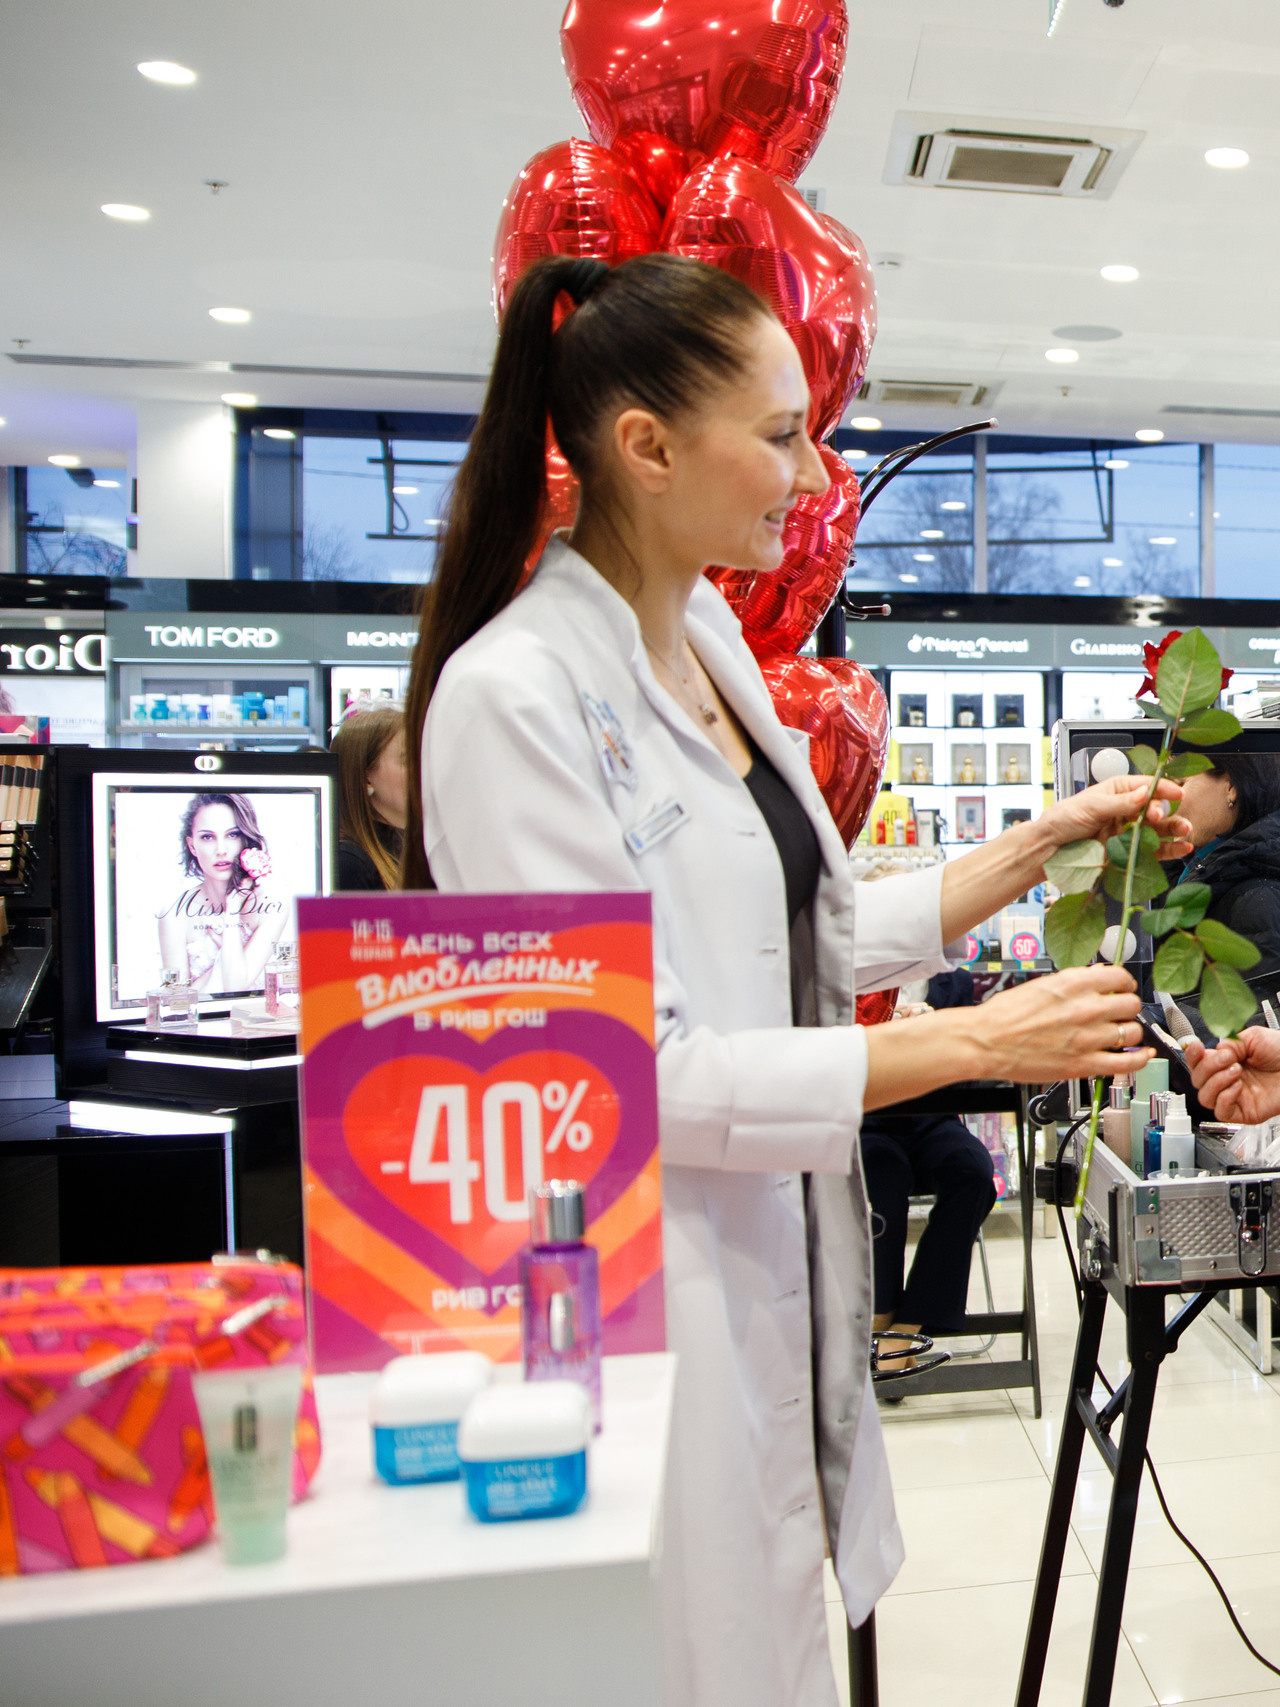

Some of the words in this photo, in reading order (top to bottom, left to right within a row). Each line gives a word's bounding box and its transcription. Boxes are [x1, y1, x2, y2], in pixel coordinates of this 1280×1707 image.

[145, 626, 201, 647] TOM
[208, 627, 278, 648] FORD
[155, 889, 226, 919] Miss
[231, 889, 283, 915] Dior
[401, 933, 475, 957] ДЕНЬ
[482, 931, 553, 953] ВСЕХ
[355, 955, 600, 1010] Влюбленных
[413, 1012, 431, 1031] В
[440, 1009, 490, 1030] РИВ
[493, 1008, 547, 1028] ГОШ
[381, 1079, 593, 1224] -40%
[432, 1287, 486, 1312] РИВ
